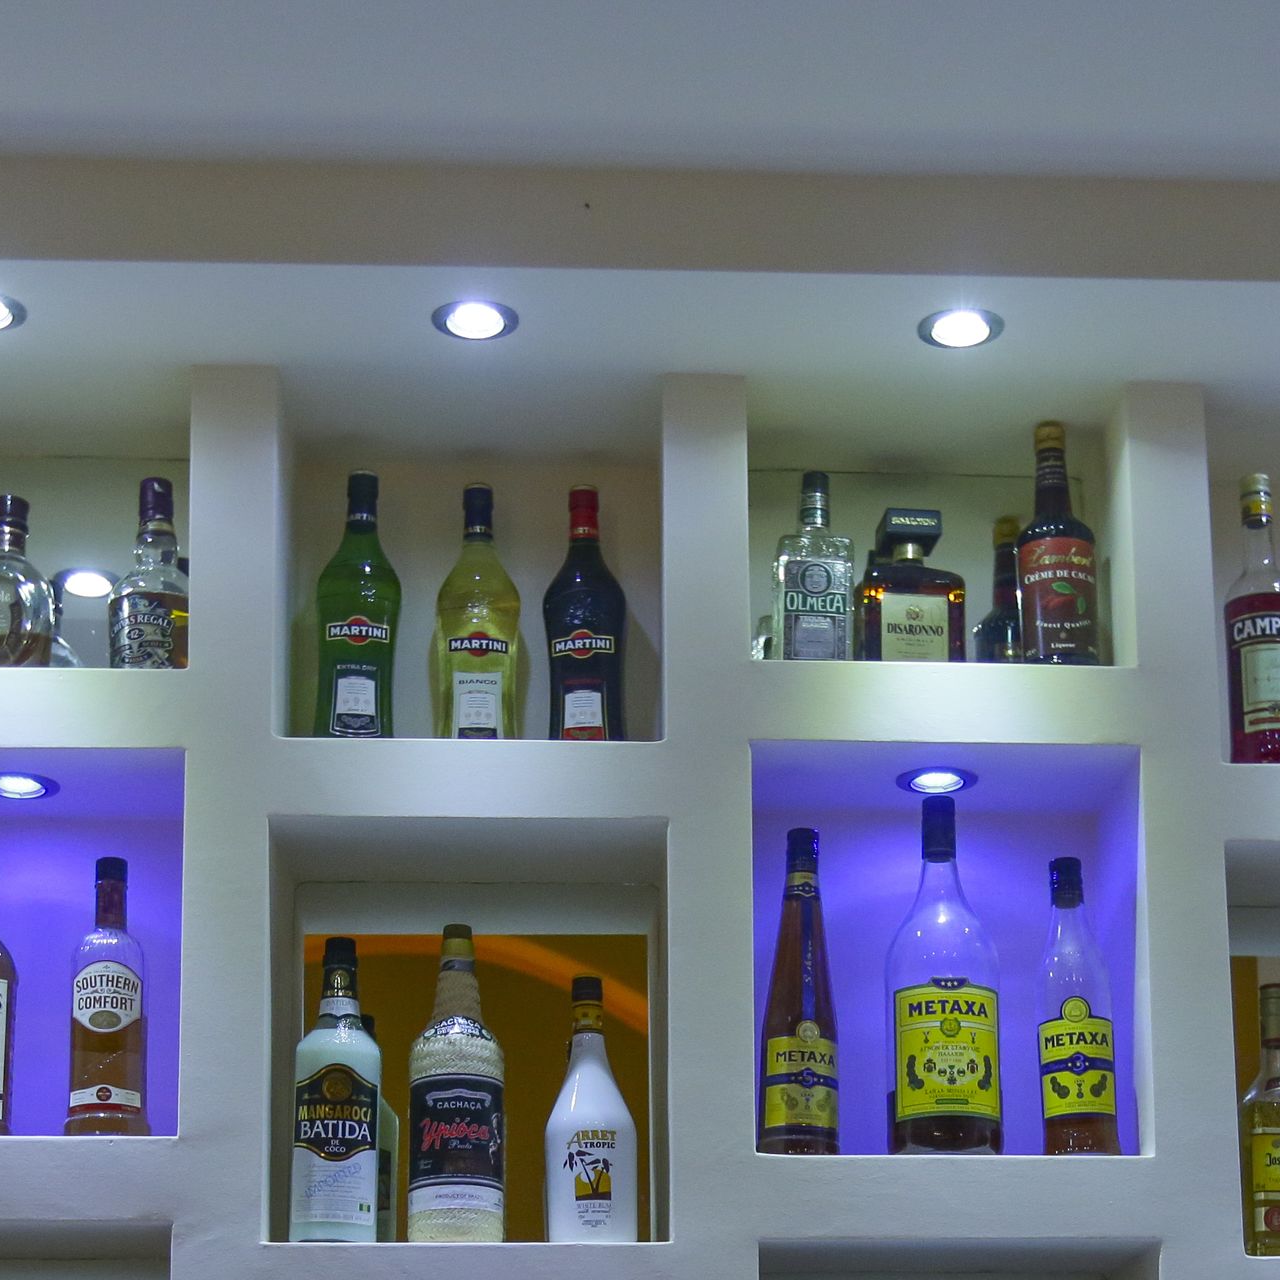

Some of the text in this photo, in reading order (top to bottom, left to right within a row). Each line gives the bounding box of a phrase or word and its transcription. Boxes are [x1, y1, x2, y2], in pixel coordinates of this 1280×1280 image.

[1056, 570, 1070, 578] DE
[786, 592, 844, 612] OLMECA
[137, 614, 170, 628] REGAL
[130, 628, 139, 640] 12
[330, 624, 387, 639] MARTINI
[887, 622, 944, 636] DISARONNO
[450, 639, 507, 652] MARTINI
[555, 639, 611, 653] MARTINI
[75, 974, 139, 995] SOUTHERN
[78, 996, 135, 1011] COMFORT
[908, 1000, 988, 1018] METAXA
[1044, 1032, 1109, 1050] METAXA
[776, 1050, 836, 1068] METAXA
[1072, 1054, 1085, 1072] 3
[802, 1070, 814, 1085] 5
[298, 1105, 371, 1121] MANGAROCA
[436, 1101, 482, 1110] CACHAÇA
[300, 1120, 372, 1142] BATIDA
[567, 1130, 617, 1149] ARRET
[584, 1141, 616, 1149] TROPIC
